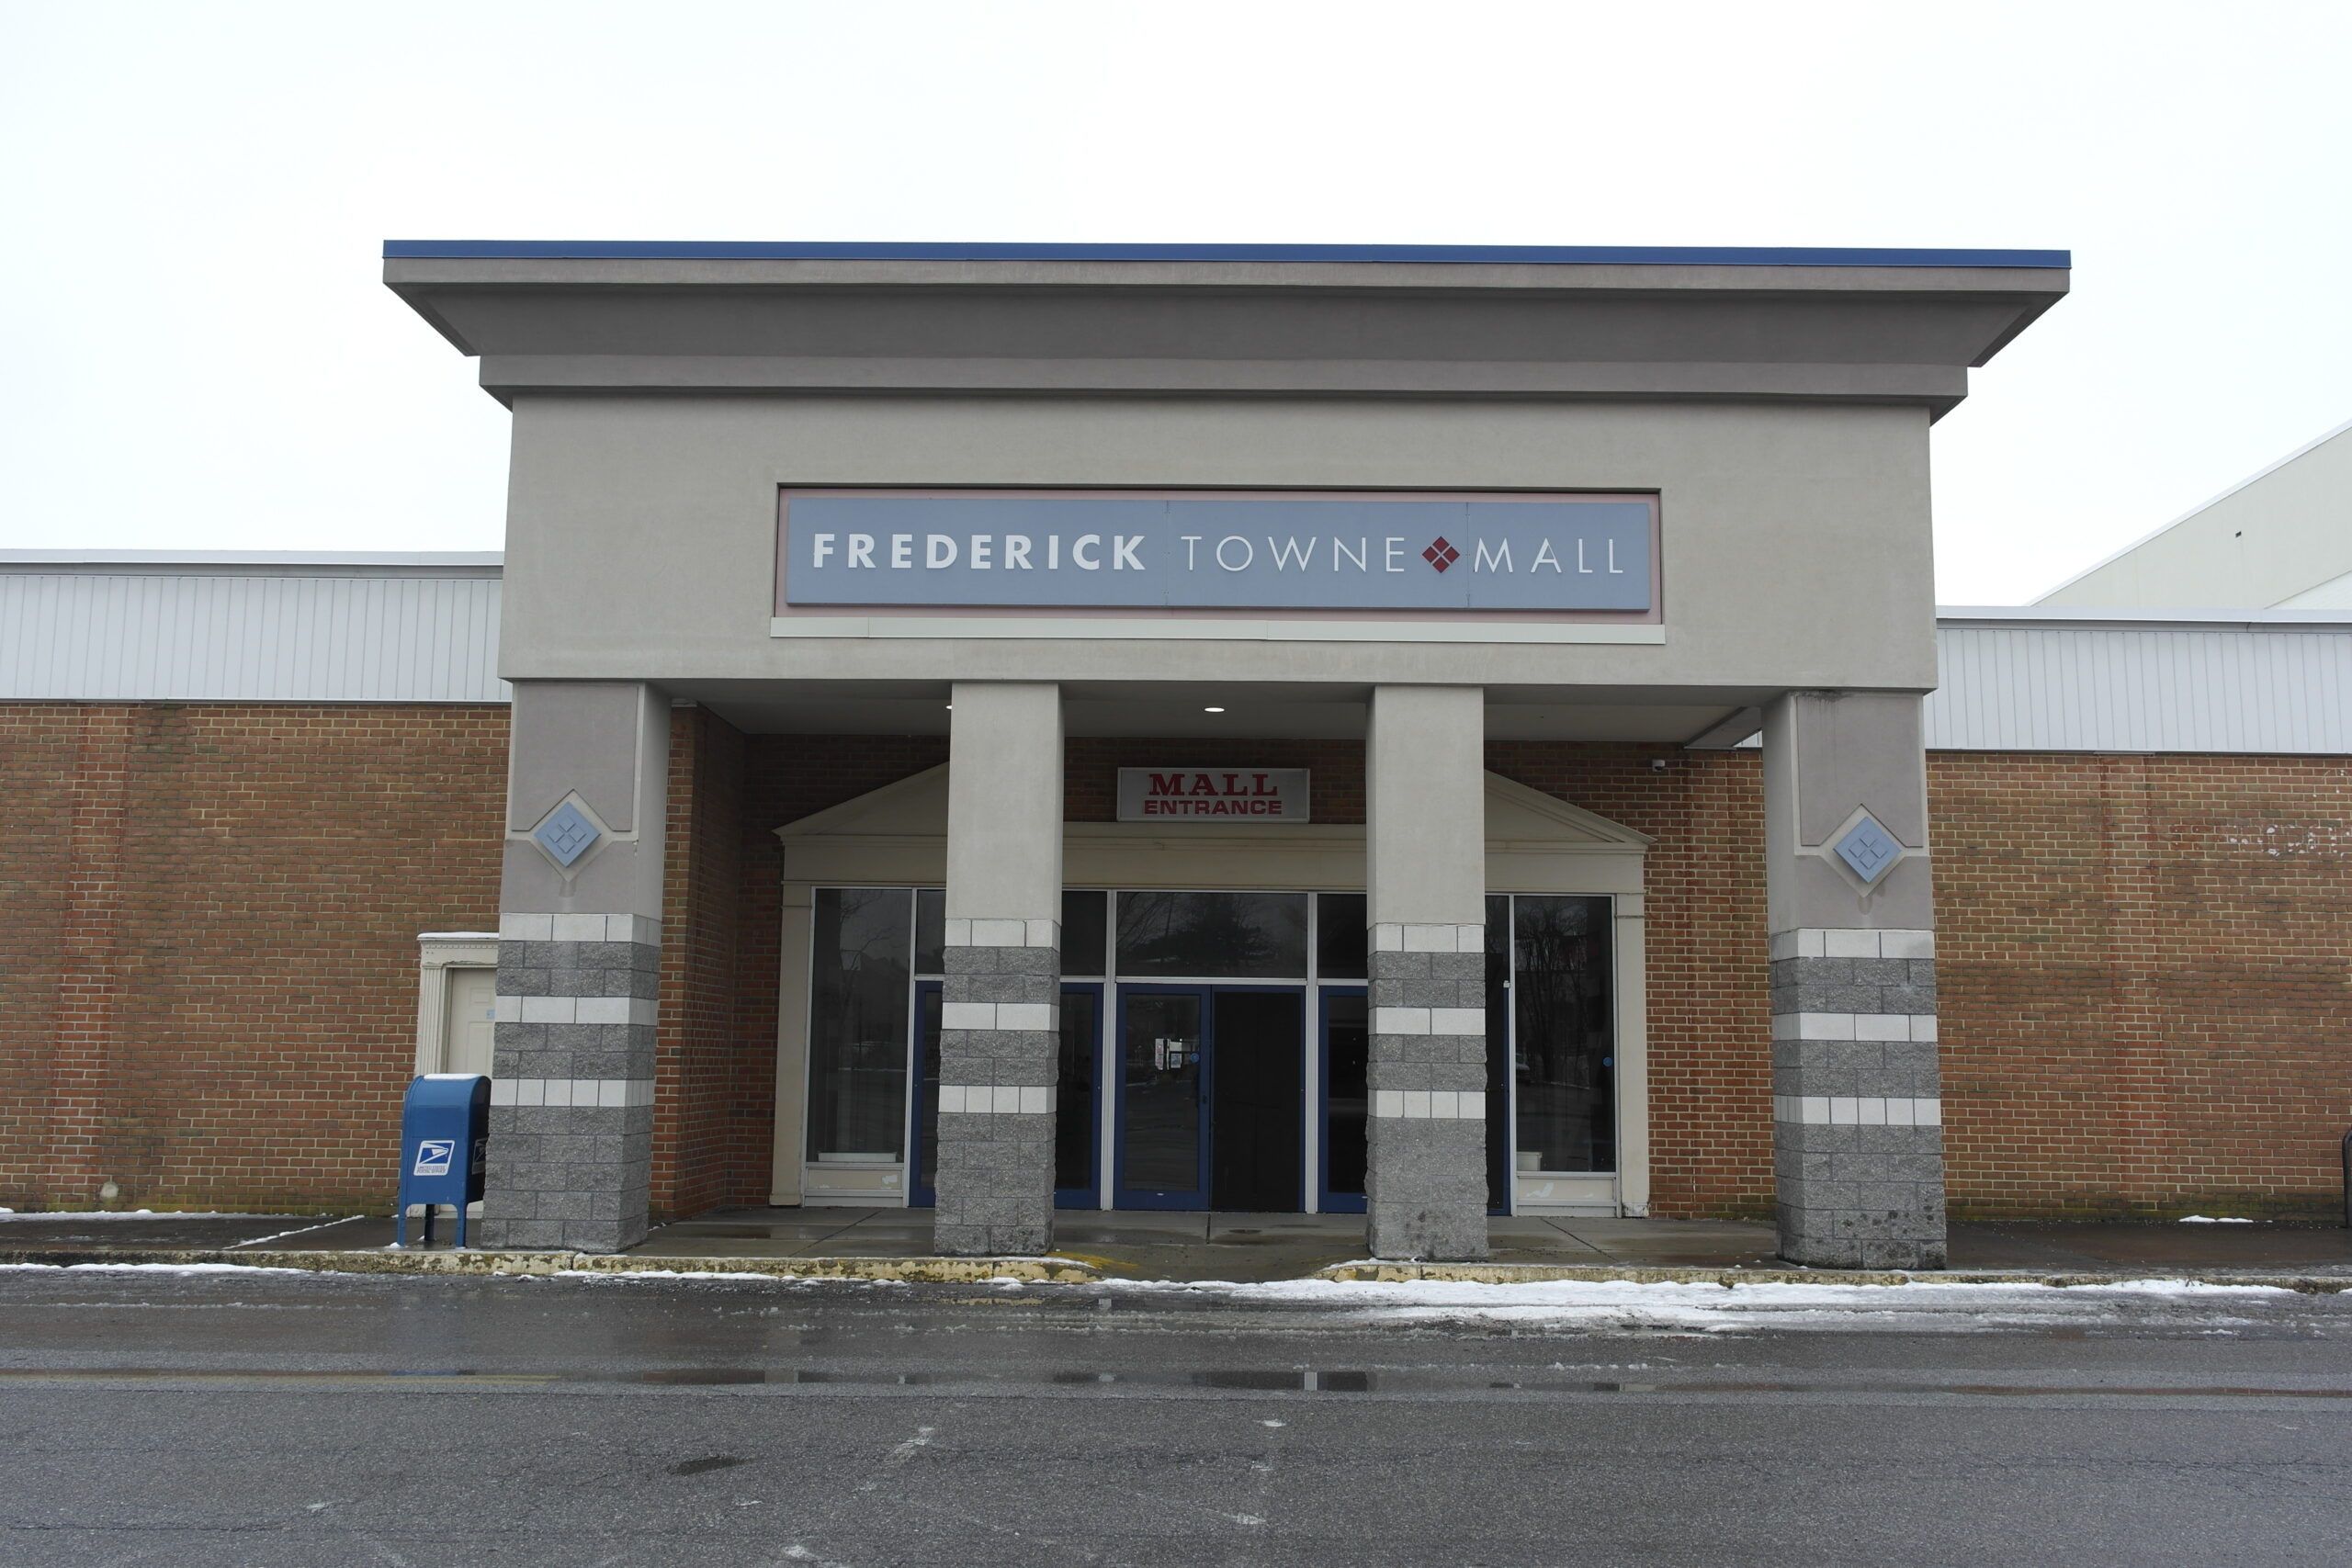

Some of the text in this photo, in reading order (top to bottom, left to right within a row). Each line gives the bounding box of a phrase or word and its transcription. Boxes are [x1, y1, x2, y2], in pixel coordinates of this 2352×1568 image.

[813, 533, 1624, 573] FREDERICK TOWNE MALL
[1149, 773, 1278, 796] MALL
[1144, 800, 1283, 815] ENTRANCE
